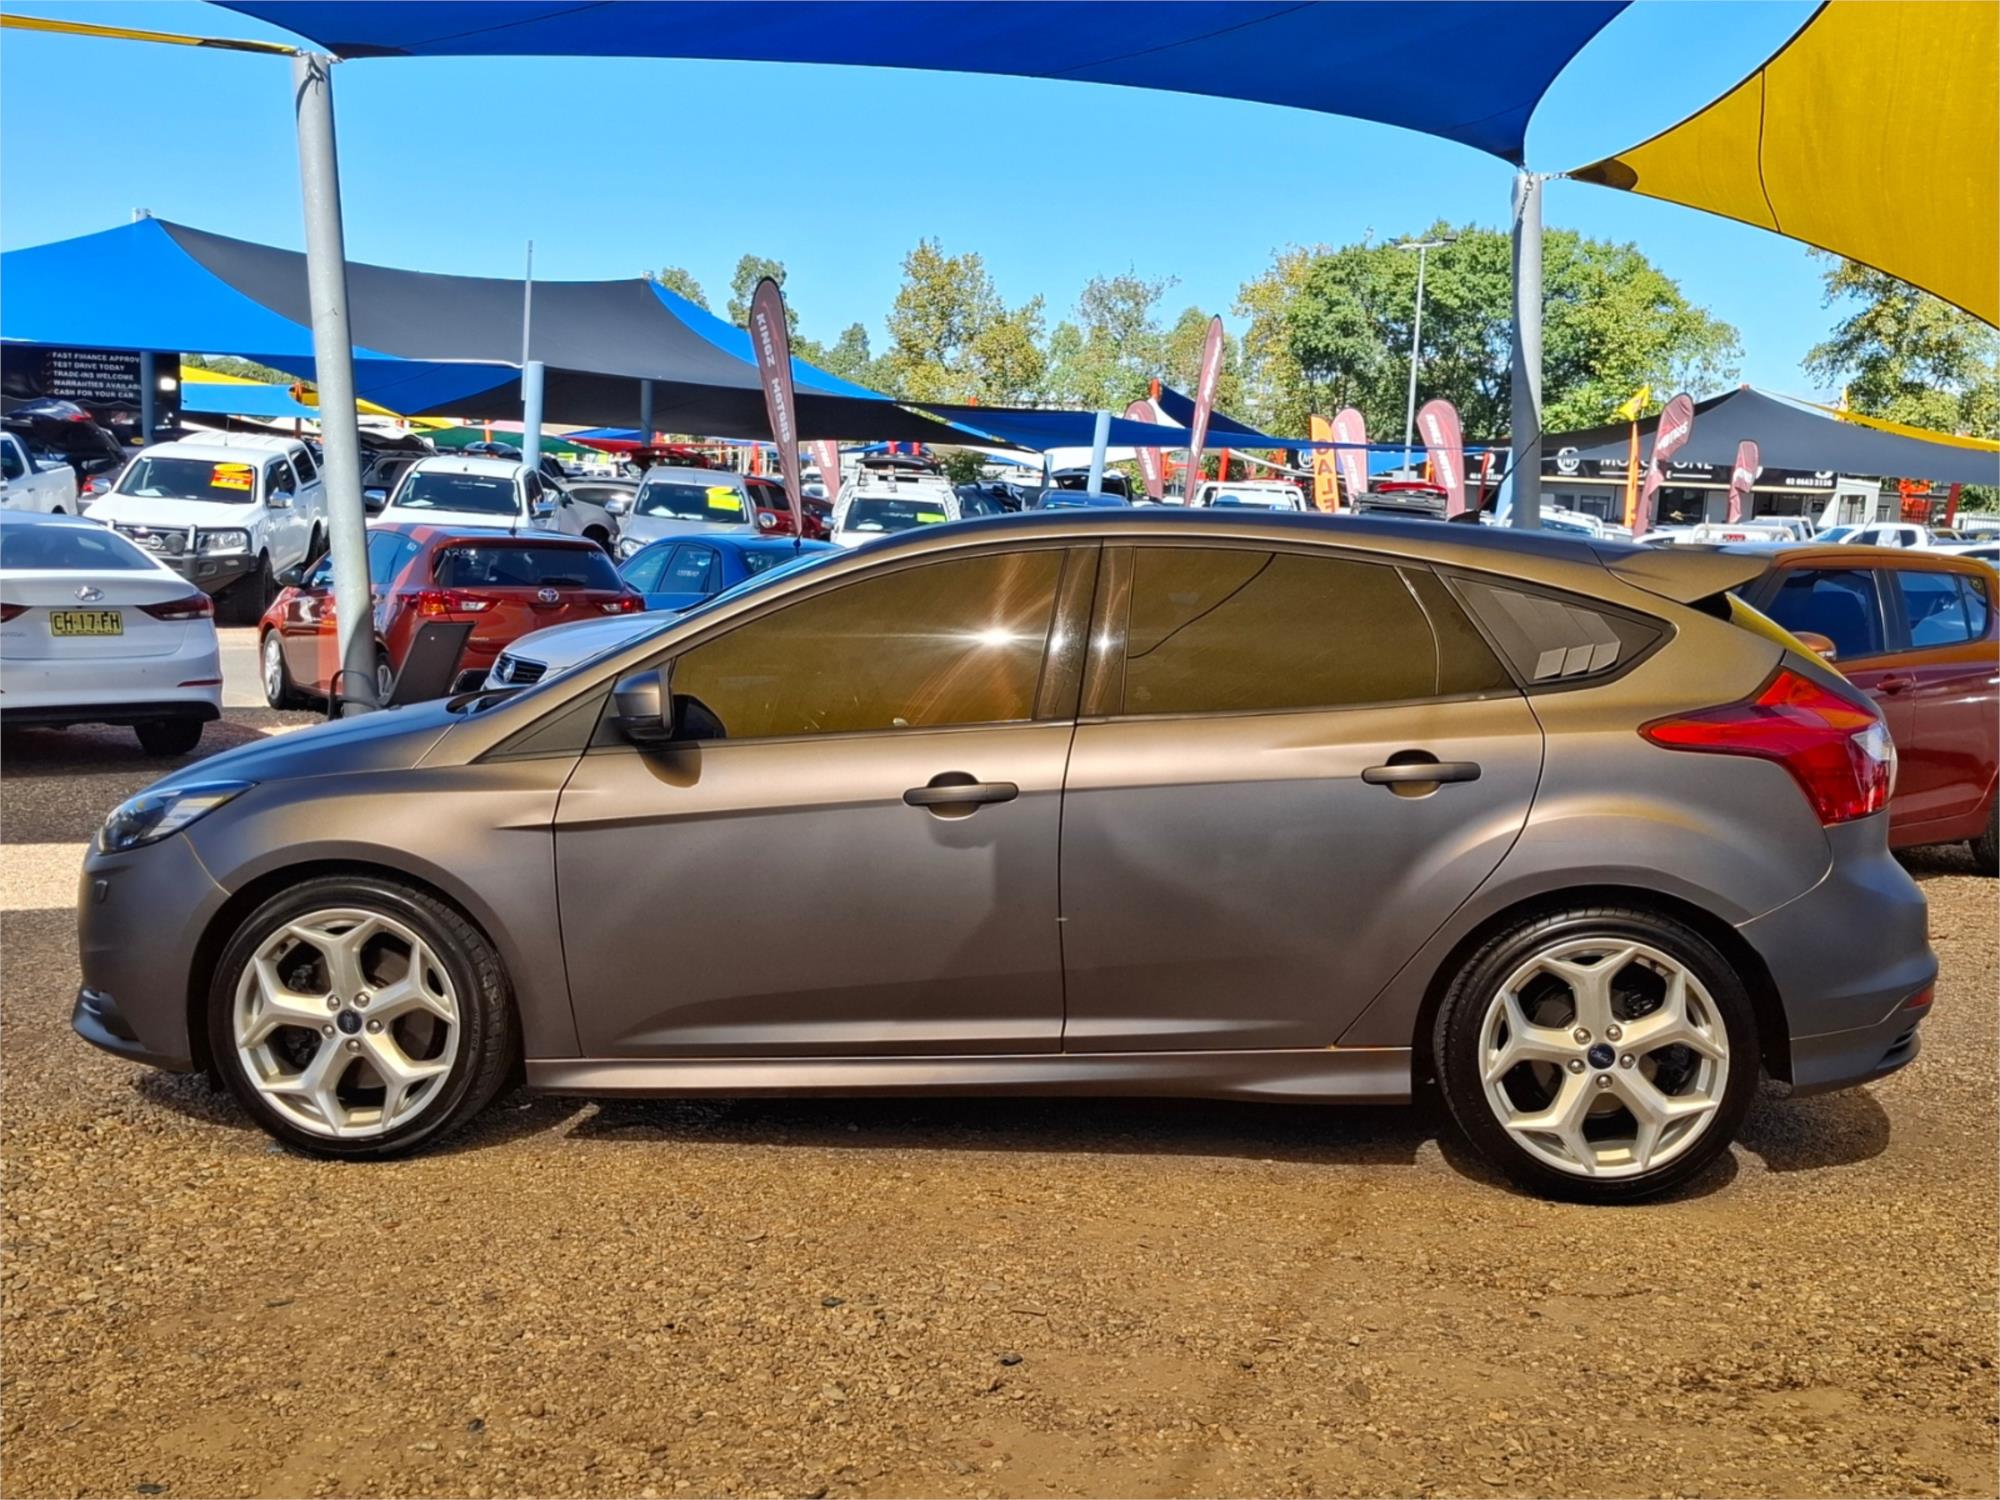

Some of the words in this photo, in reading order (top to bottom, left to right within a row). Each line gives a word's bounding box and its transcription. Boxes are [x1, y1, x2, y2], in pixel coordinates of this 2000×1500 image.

[52, 351, 72, 359] FAST
[53, 361, 72, 369] TEST
[74, 362, 97, 370] DRIVE
[54, 388, 76, 396] CASH
[77, 389, 93, 397] FOR
[95, 390, 116, 398] YOUR
